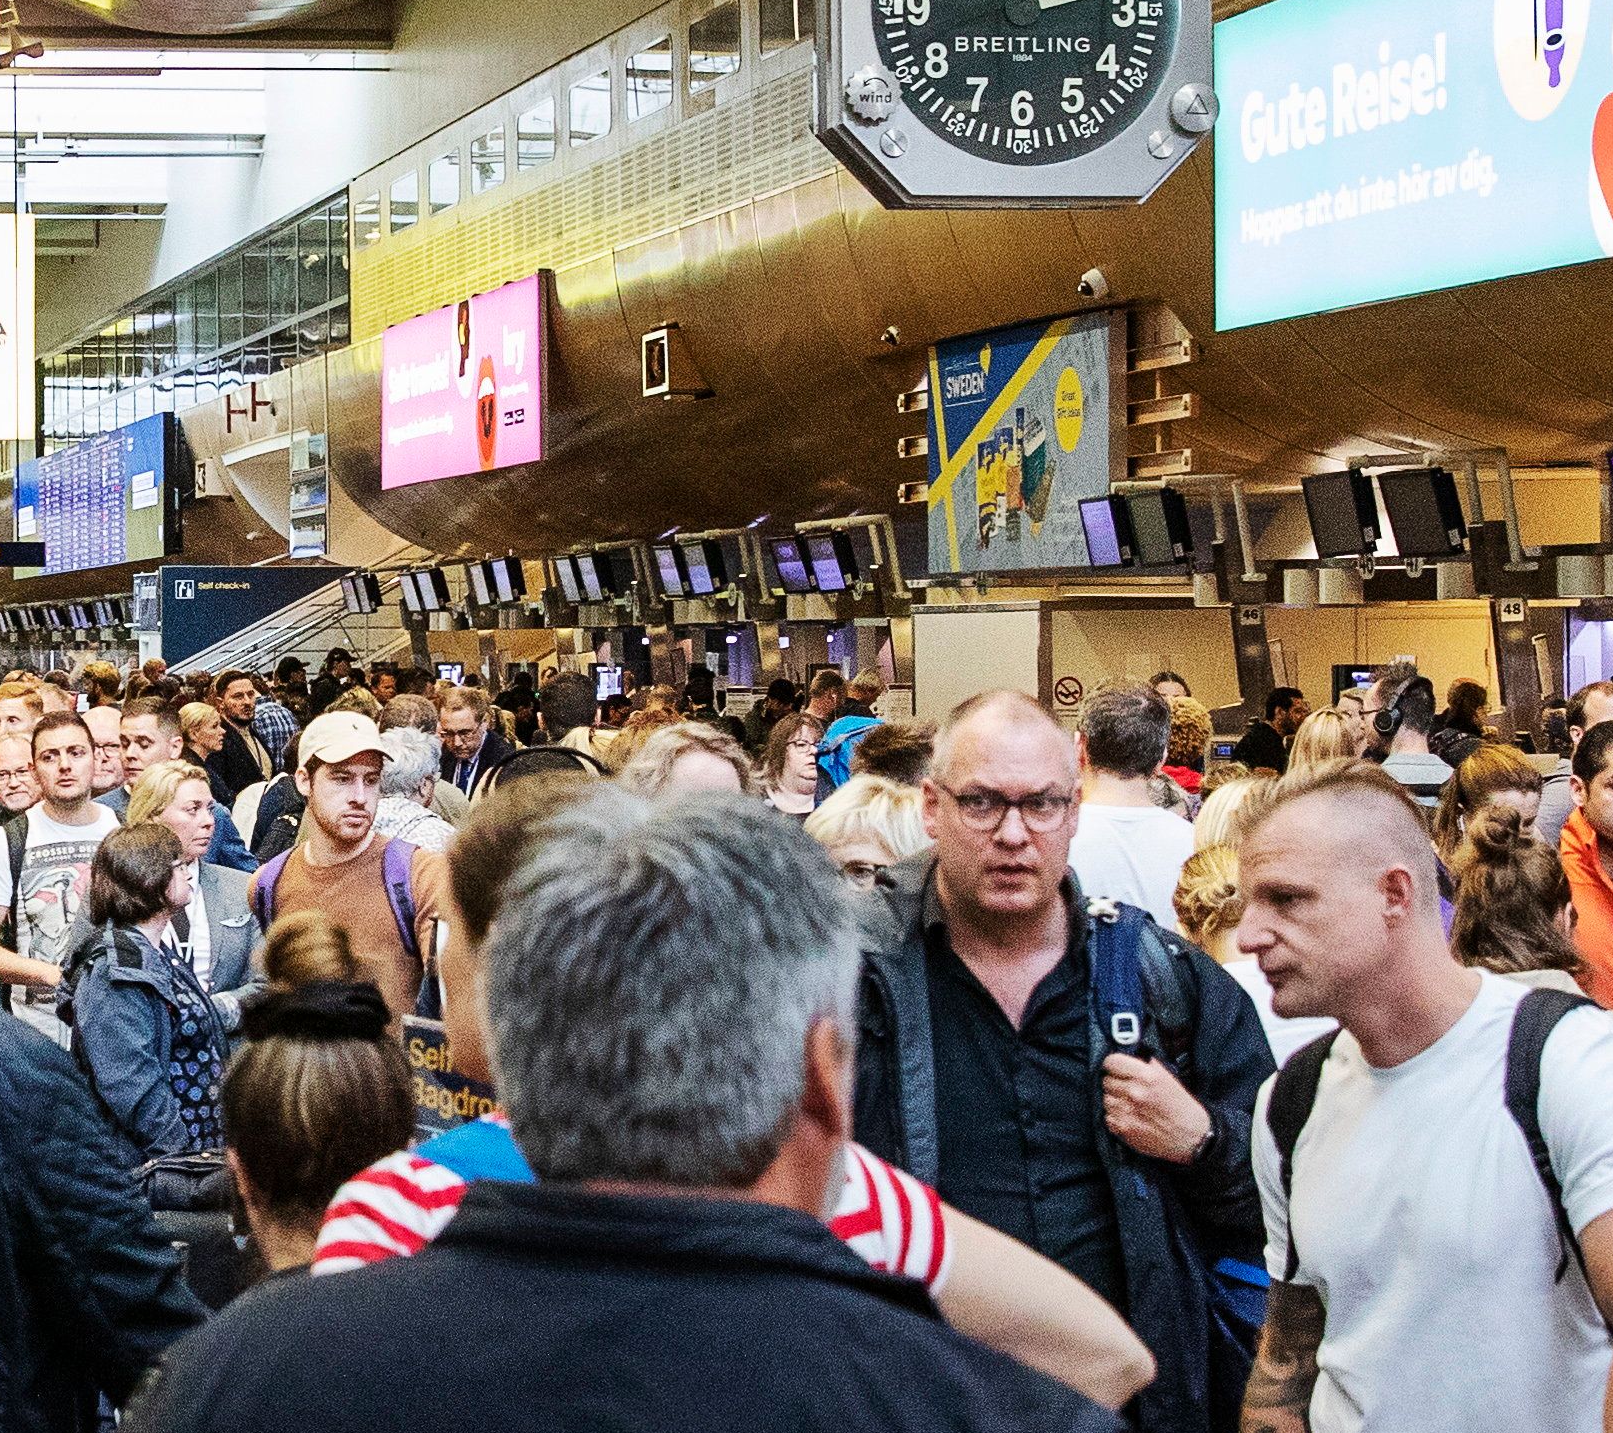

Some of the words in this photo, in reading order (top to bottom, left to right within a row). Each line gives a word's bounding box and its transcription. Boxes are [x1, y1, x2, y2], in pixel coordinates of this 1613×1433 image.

[1149, 2, 1163, 17] 15
[955, 37, 1091, 53] BREITLING
[925, 43, 949, 79] 8
[1012, 54, 1033, 62] 1884
[1096, 43, 1120, 79] 4
[1131, 69, 1149, 90] 20
[859, 91, 892, 105] wind
[966, 77, 989, 112] 7
[1061, 78, 1085, 113] 5
[1240, 82, 1327, 164] Gute
[1331, 31, 1448, 146] Reise!
[1010, 90, 1034, 126] 6
[946, 119, 966, 137] 35
[1081, 120, 1100, 140] 25
[1012, 139, 1033, 154] 30
[1240, 203, 1304, 247] Hoppas
[1305, 190, 1332, 227] att
[1334, 184, 1358, 220] du
[1359, 175, 1396, 214] inte
[1398, 163, 1432, 205] hör
[1433, 165, 1459, 197] av
[946, 371, 985, 399] SWEDEN
[197, 580, 216, 591] Self
[218, 580, 251, 591] check-in
[1241, 607, 1260, 621] 46
[1502, 602, 1522, 617] 48
[30, 846, 75, 860] CROSSED
[413, 1076, 499, 1119] Bagdro
